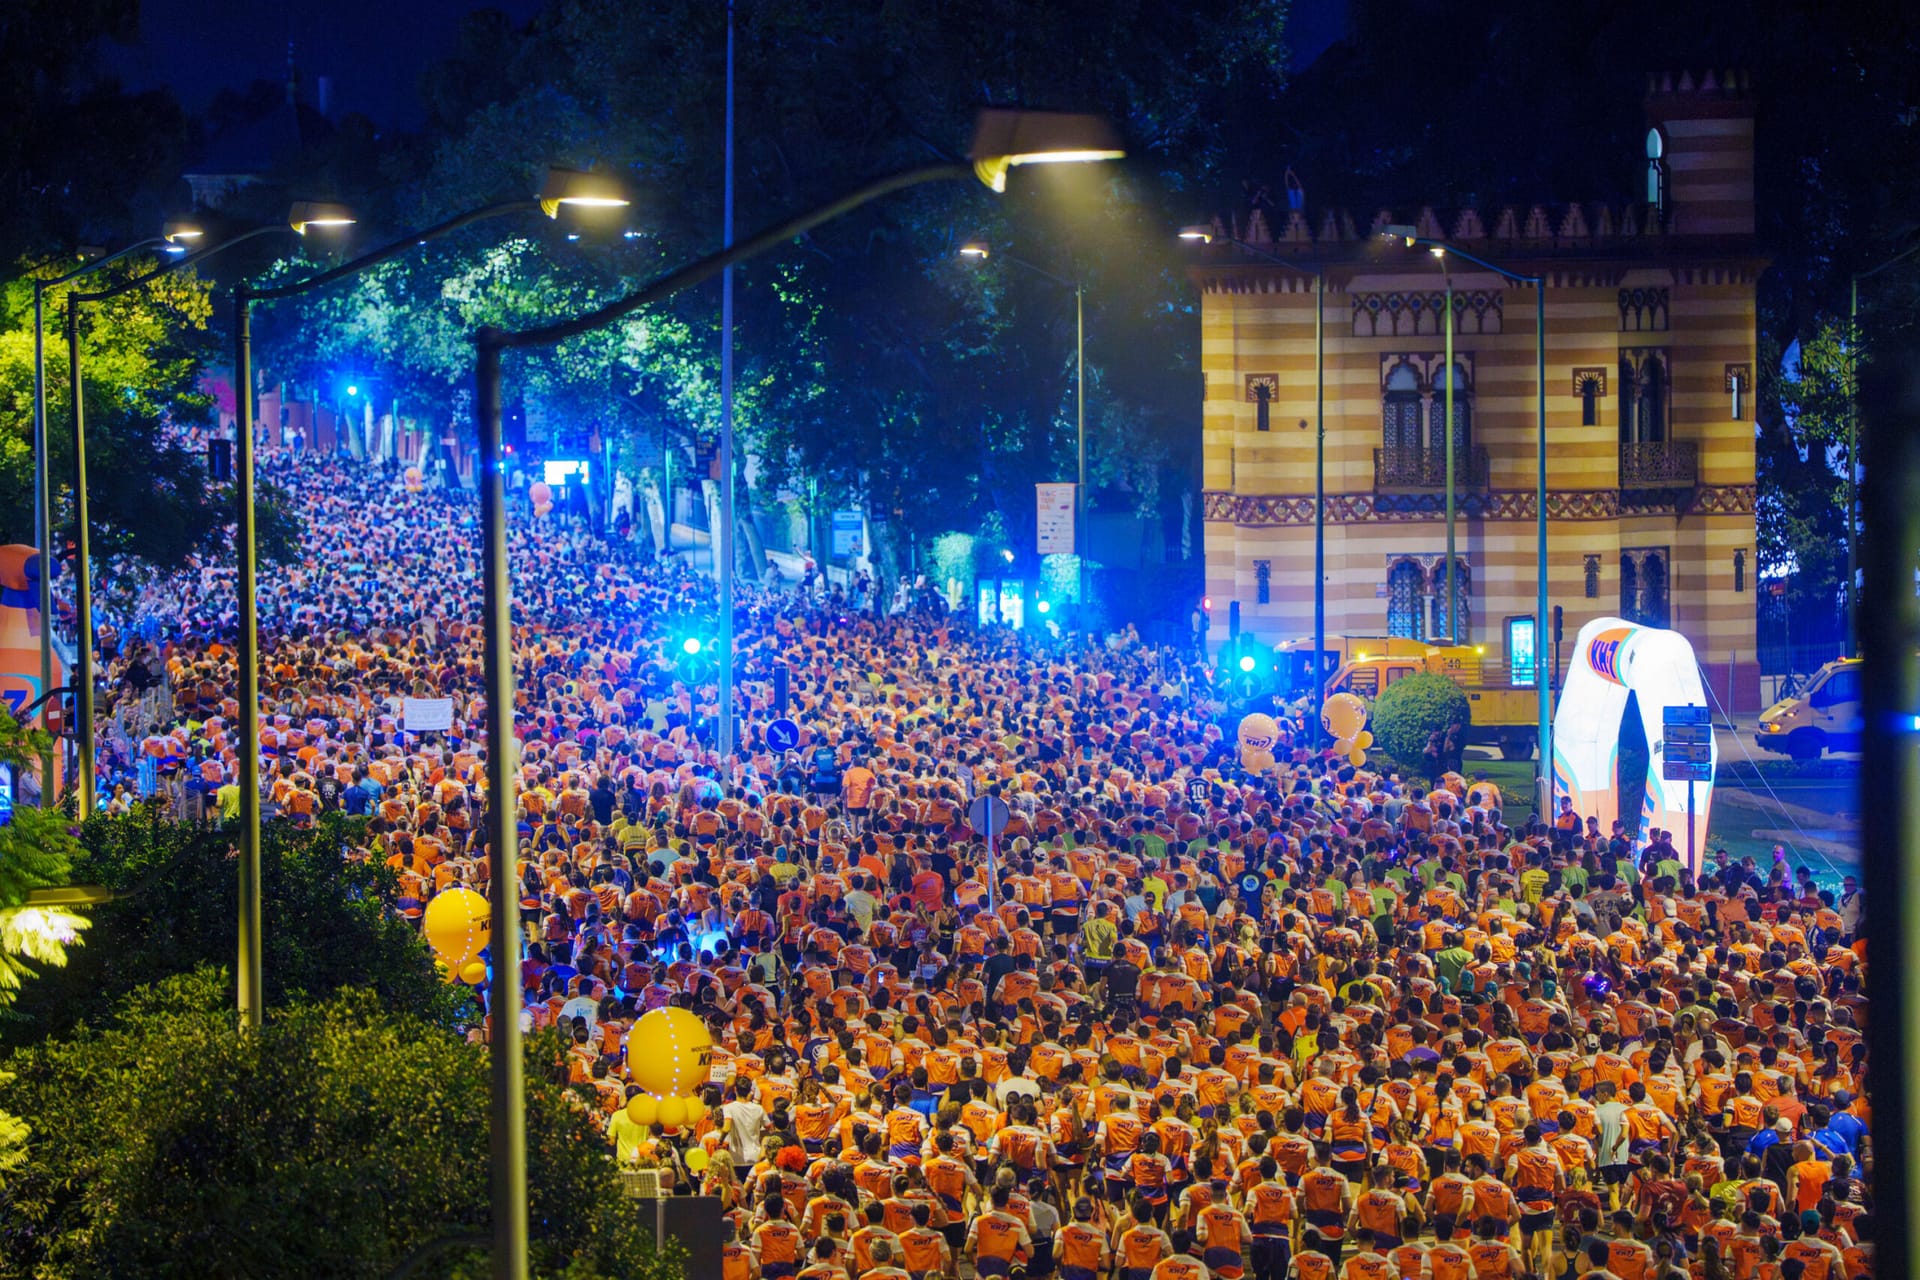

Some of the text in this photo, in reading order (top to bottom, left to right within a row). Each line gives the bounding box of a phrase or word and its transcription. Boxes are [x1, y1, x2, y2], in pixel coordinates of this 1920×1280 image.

[1591, 640, 1620, 679] KH-7
[1246, 737, 1271, 749] KH7
[1192, 784, 1204, 800] 10
